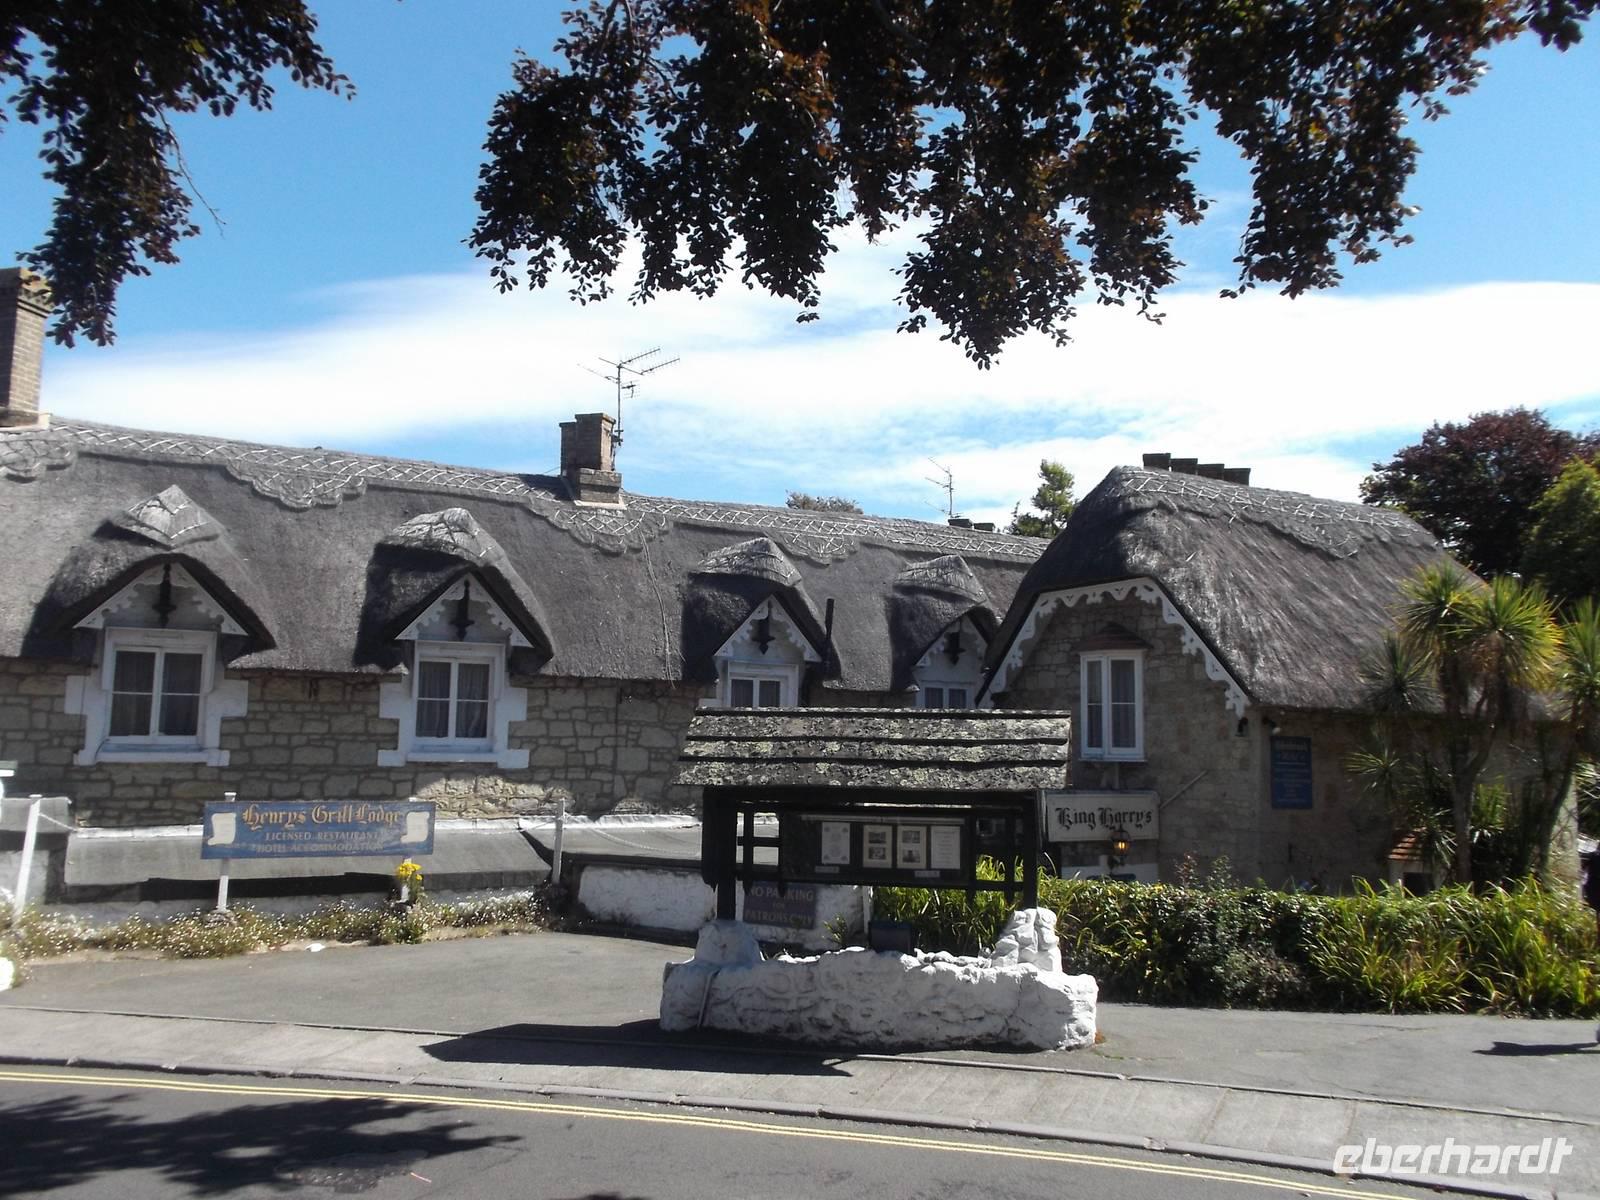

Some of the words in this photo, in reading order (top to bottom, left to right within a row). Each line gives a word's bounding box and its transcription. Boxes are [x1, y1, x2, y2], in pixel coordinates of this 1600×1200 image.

[243, 804, 307, 831] Henrys
[311, 804, 352, 824] Grill
[355, 804, 401, 827] Lodge
[1055, 807, 1096, 830] King
[1098, 807, 1153, 830] Harry's
[265, 831, 312, 841] LICENSED
[318, 831, 380, 841] RESTAURANT
[766, 886, 814, 902] PAKING
